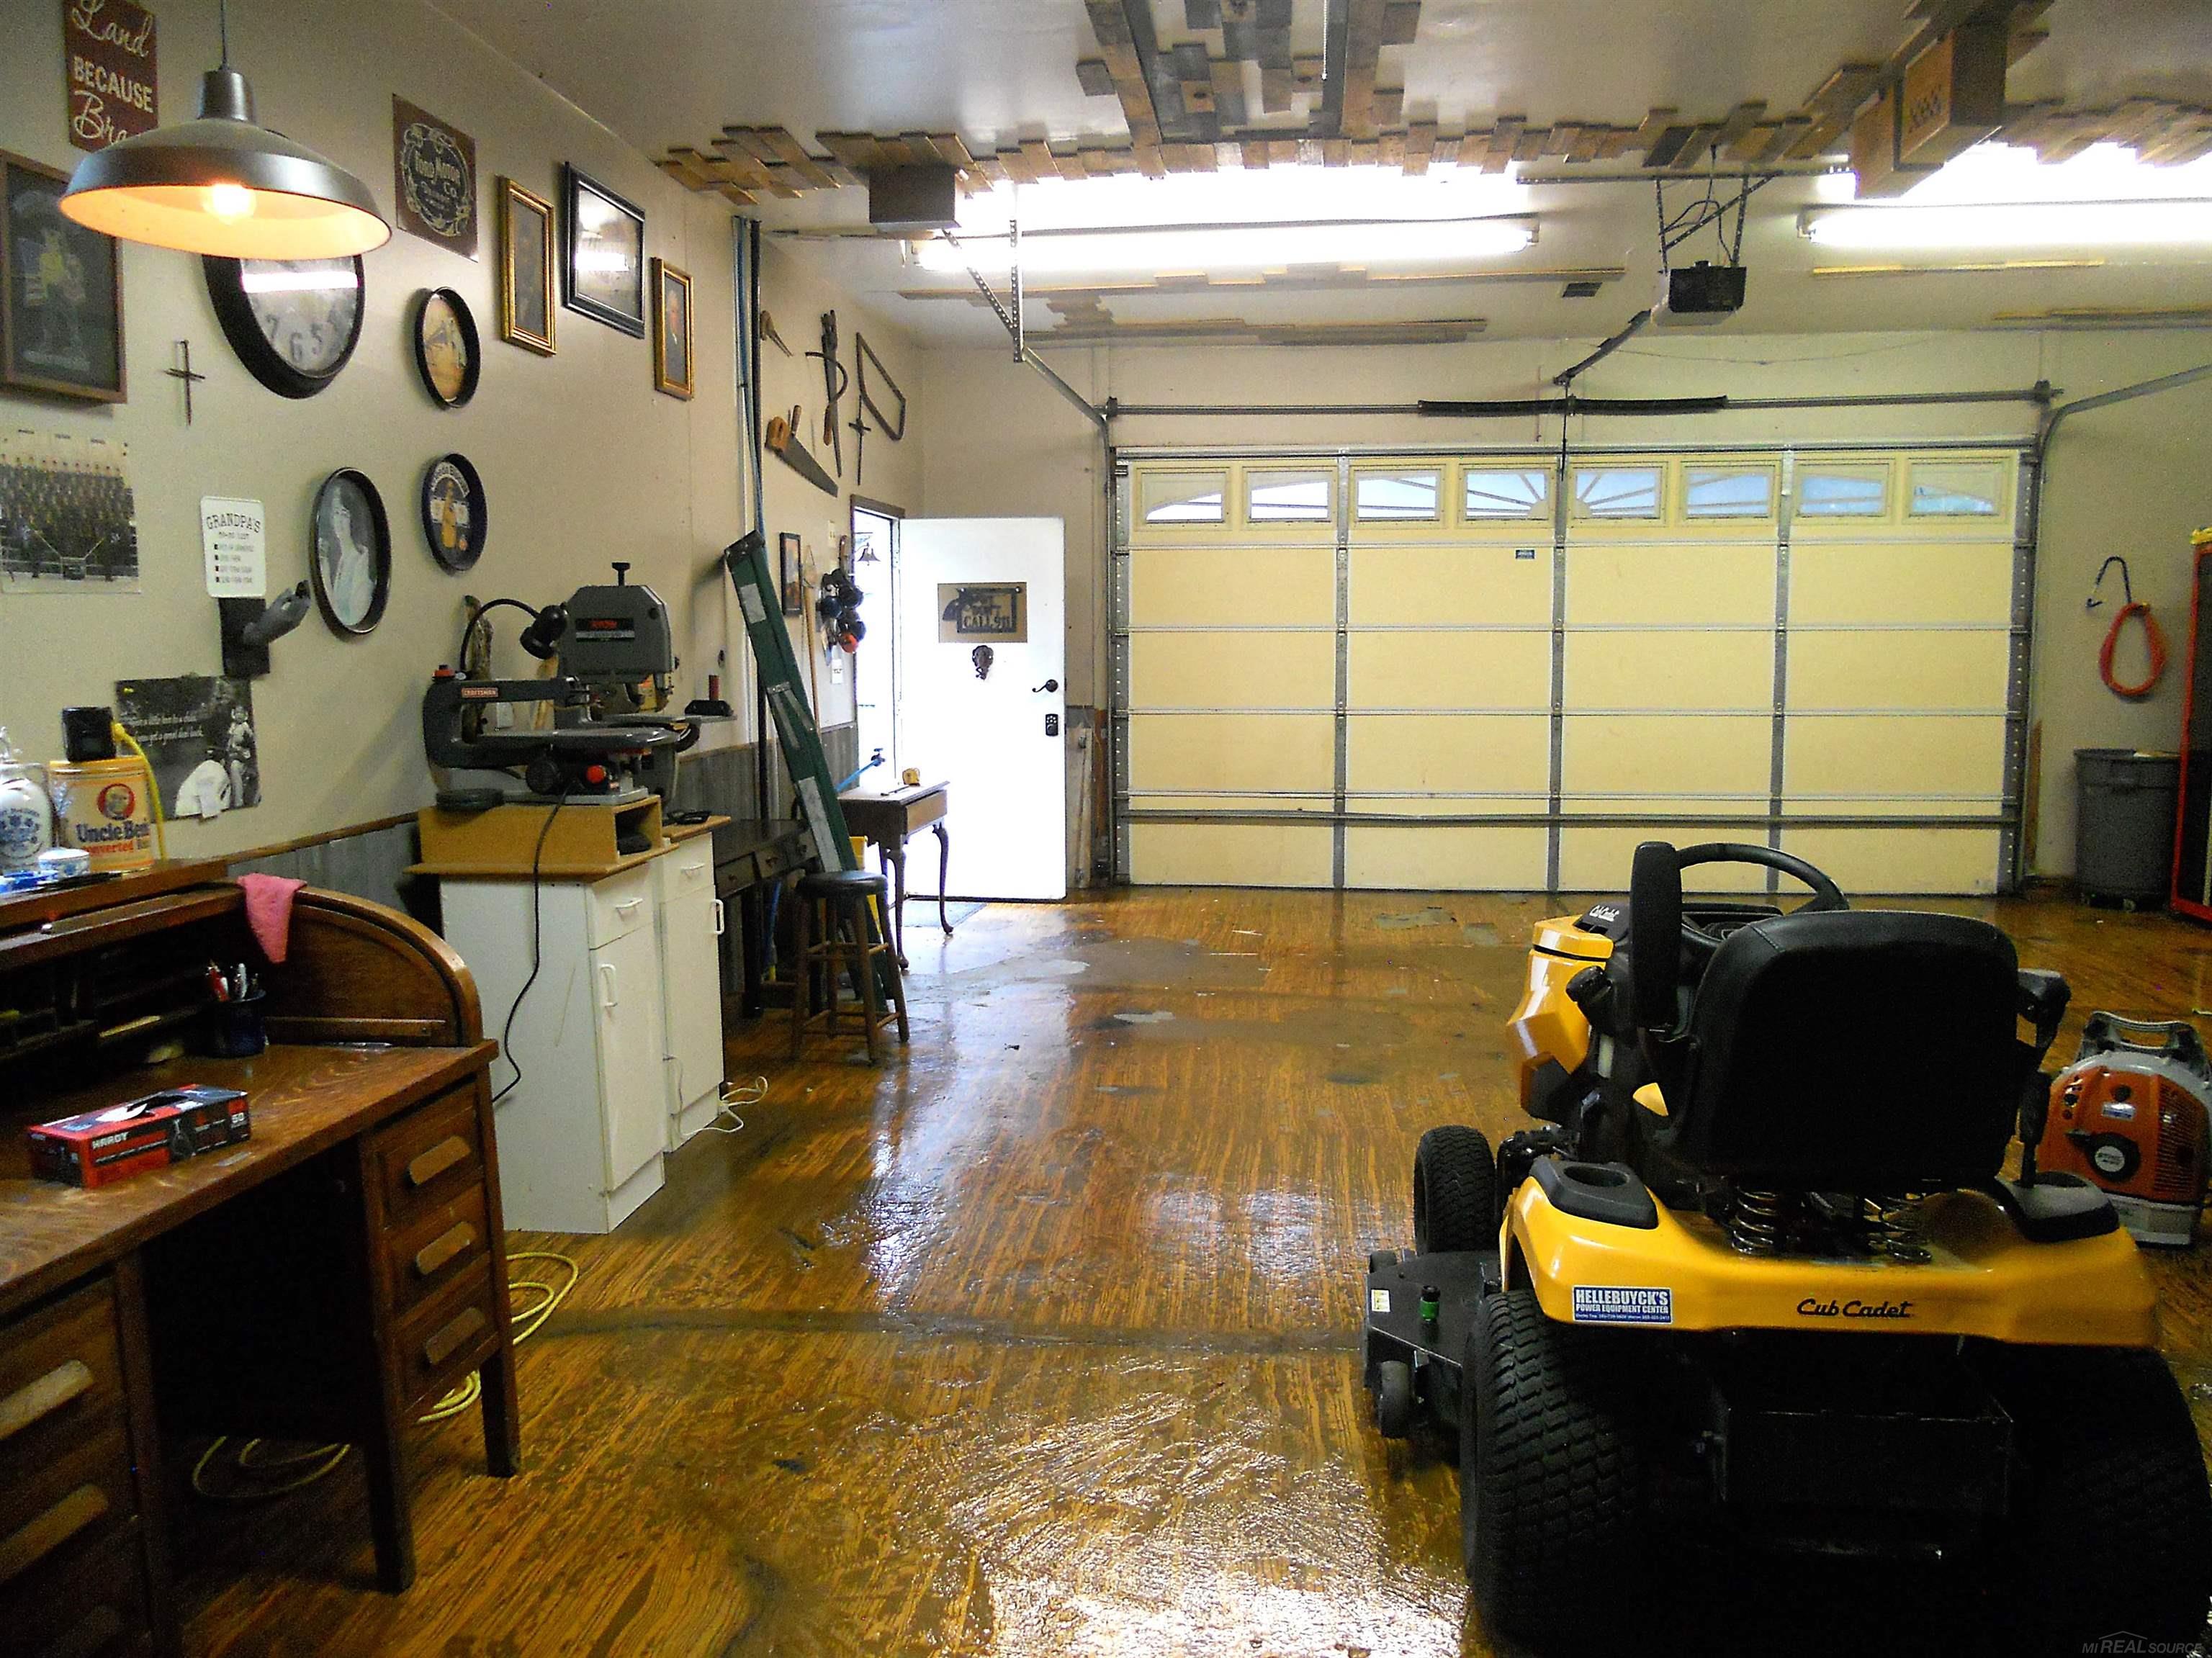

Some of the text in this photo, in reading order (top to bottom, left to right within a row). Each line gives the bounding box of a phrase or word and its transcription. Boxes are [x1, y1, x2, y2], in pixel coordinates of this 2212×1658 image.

[73, 55, 153, 113] BECAUSE
[206, 513, 261, 533] GRANDPA'S
[76, 823, 123, 842] Uncle
[91, 1131, 130, 1150] HARDY
[1575, 1289, 1668, 1305] HELLEBUYCK'S
[1575, 1303, 1669, 1314] POWER EQUIPMENT CENTER
[1797, 1298, 1913, 1317] Cub Cadet
